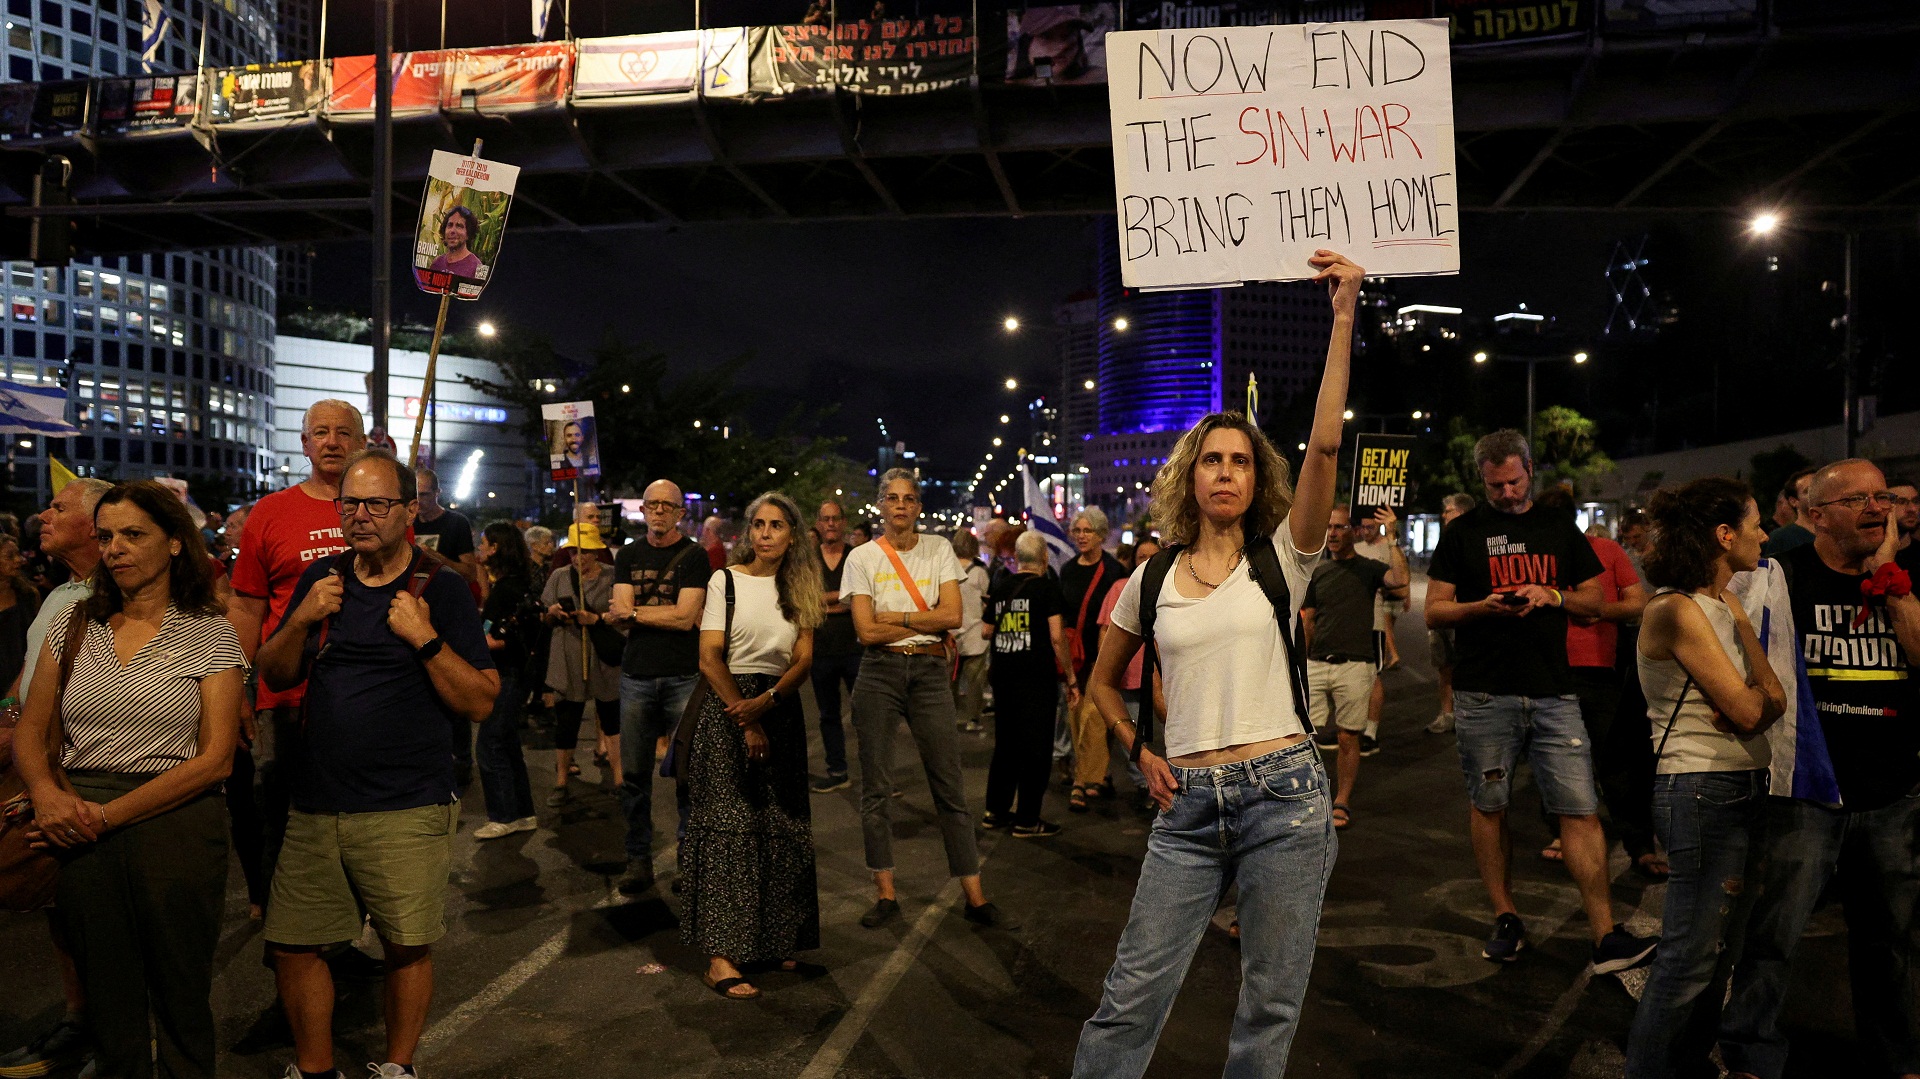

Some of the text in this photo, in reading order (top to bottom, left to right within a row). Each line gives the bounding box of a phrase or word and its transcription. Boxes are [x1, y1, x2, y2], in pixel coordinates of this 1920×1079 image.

[933, 14, 963, 34] כל
[1474, 0, 1580, 40] לעסקה
[822, 45, 854, 61] את
[905, 36, 980, 59] תחזירו
[878, 61, 923, 80] לירי
[1138, 29, 1426, 100] NOW END
[1125, 112, 1217, 173] THE
[1122, 172, 1456, 262] BRING THEM HOME
[417, 241, 438, 256] BRING
[1362, 447, 1410, 468] GET MY
[1360, 466, 1408, 486] PEOPLE
[1357, 485, 1406, 507] HOME!
[1486, 534, 1508, 547] BRING
[1487, 543, 1527, 556] THEM HOME
[1489, 553, 1557, 587] NOW!
